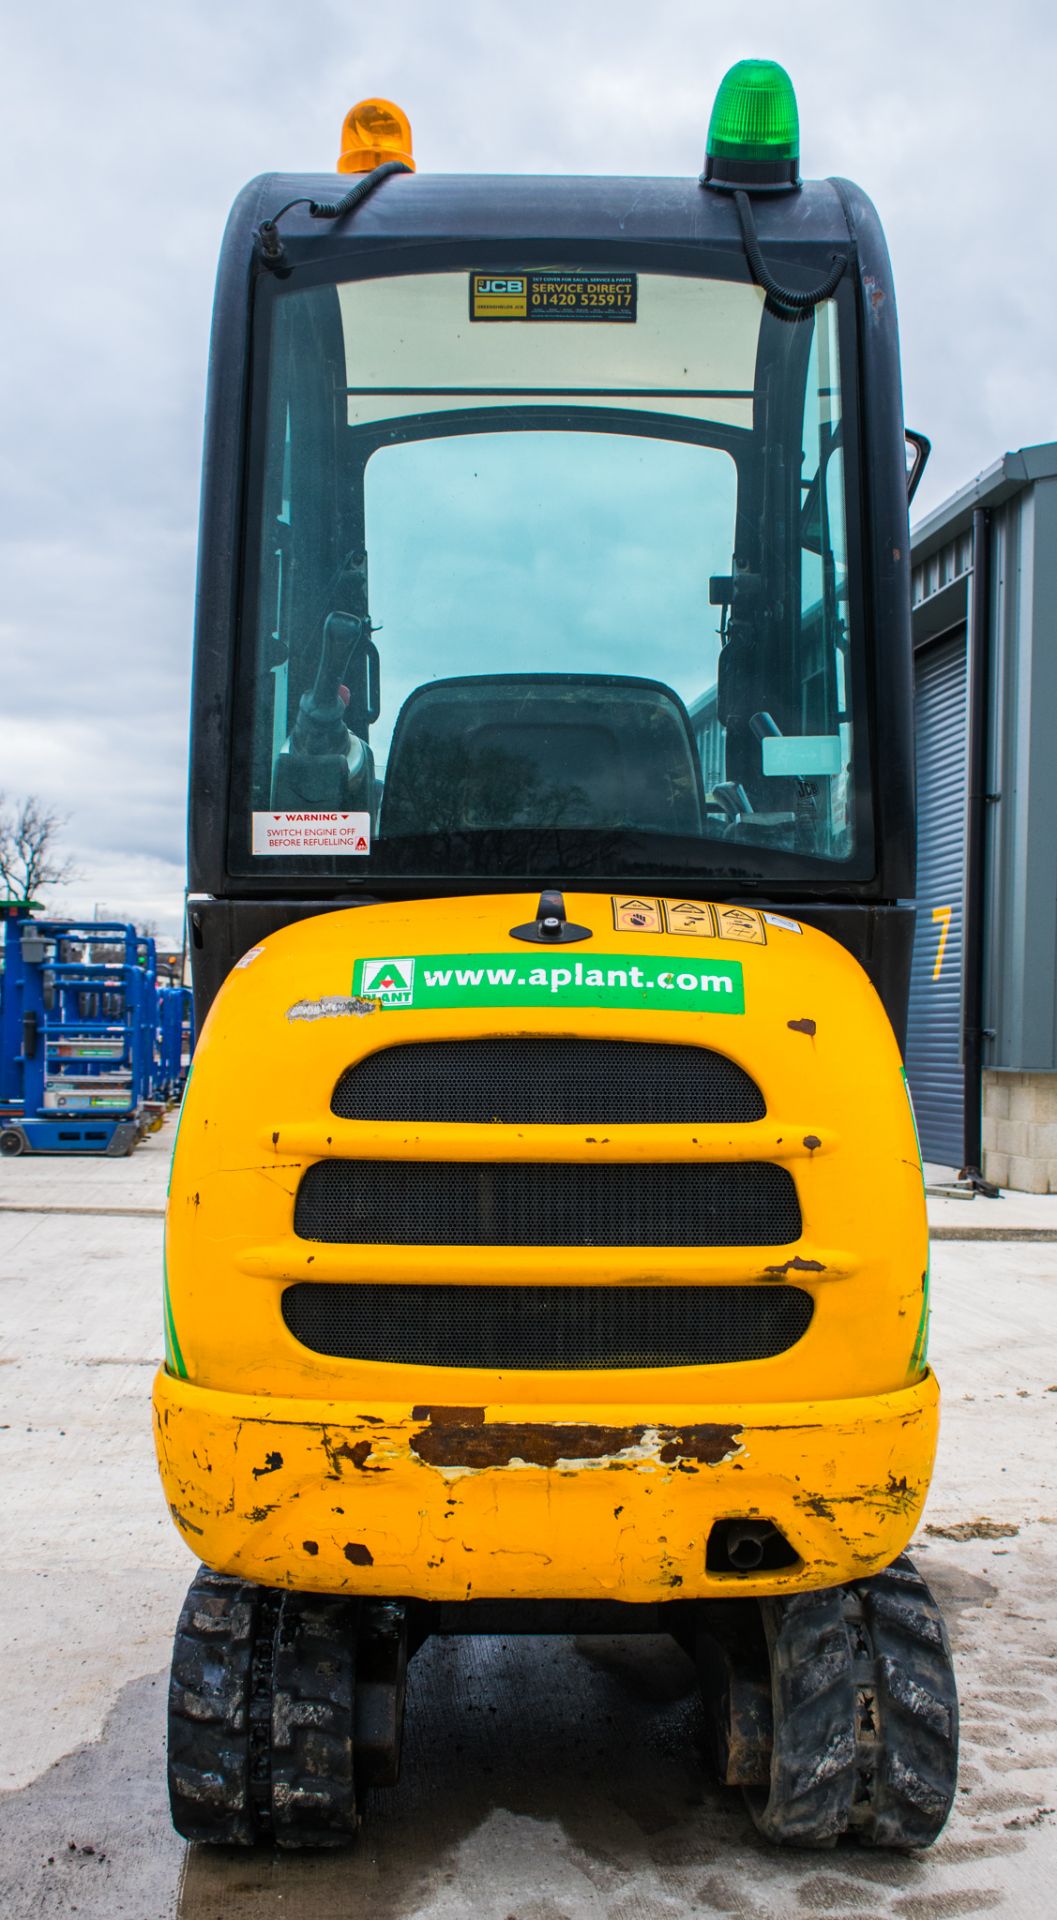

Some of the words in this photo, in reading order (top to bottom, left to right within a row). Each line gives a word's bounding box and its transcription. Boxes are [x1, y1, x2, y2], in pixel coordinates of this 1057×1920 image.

[478, 280, 523, 293] JCB
[532, 284, 583, 293] SERVICE
[587, 284, 632, 293] DIRECT
[531, 293, 576, 305] 01420
[580, 294, 632, 306] 525917
[267, 829, 302, 837] SWITCH
[339, 828, 356, 836] OFF
[304, 838, 354, 846] REFUELLING
[931, 905, 952, 981] 7
[367, 963, 408, 990] A
[423, 962, 734, 993] www.aplant.com
